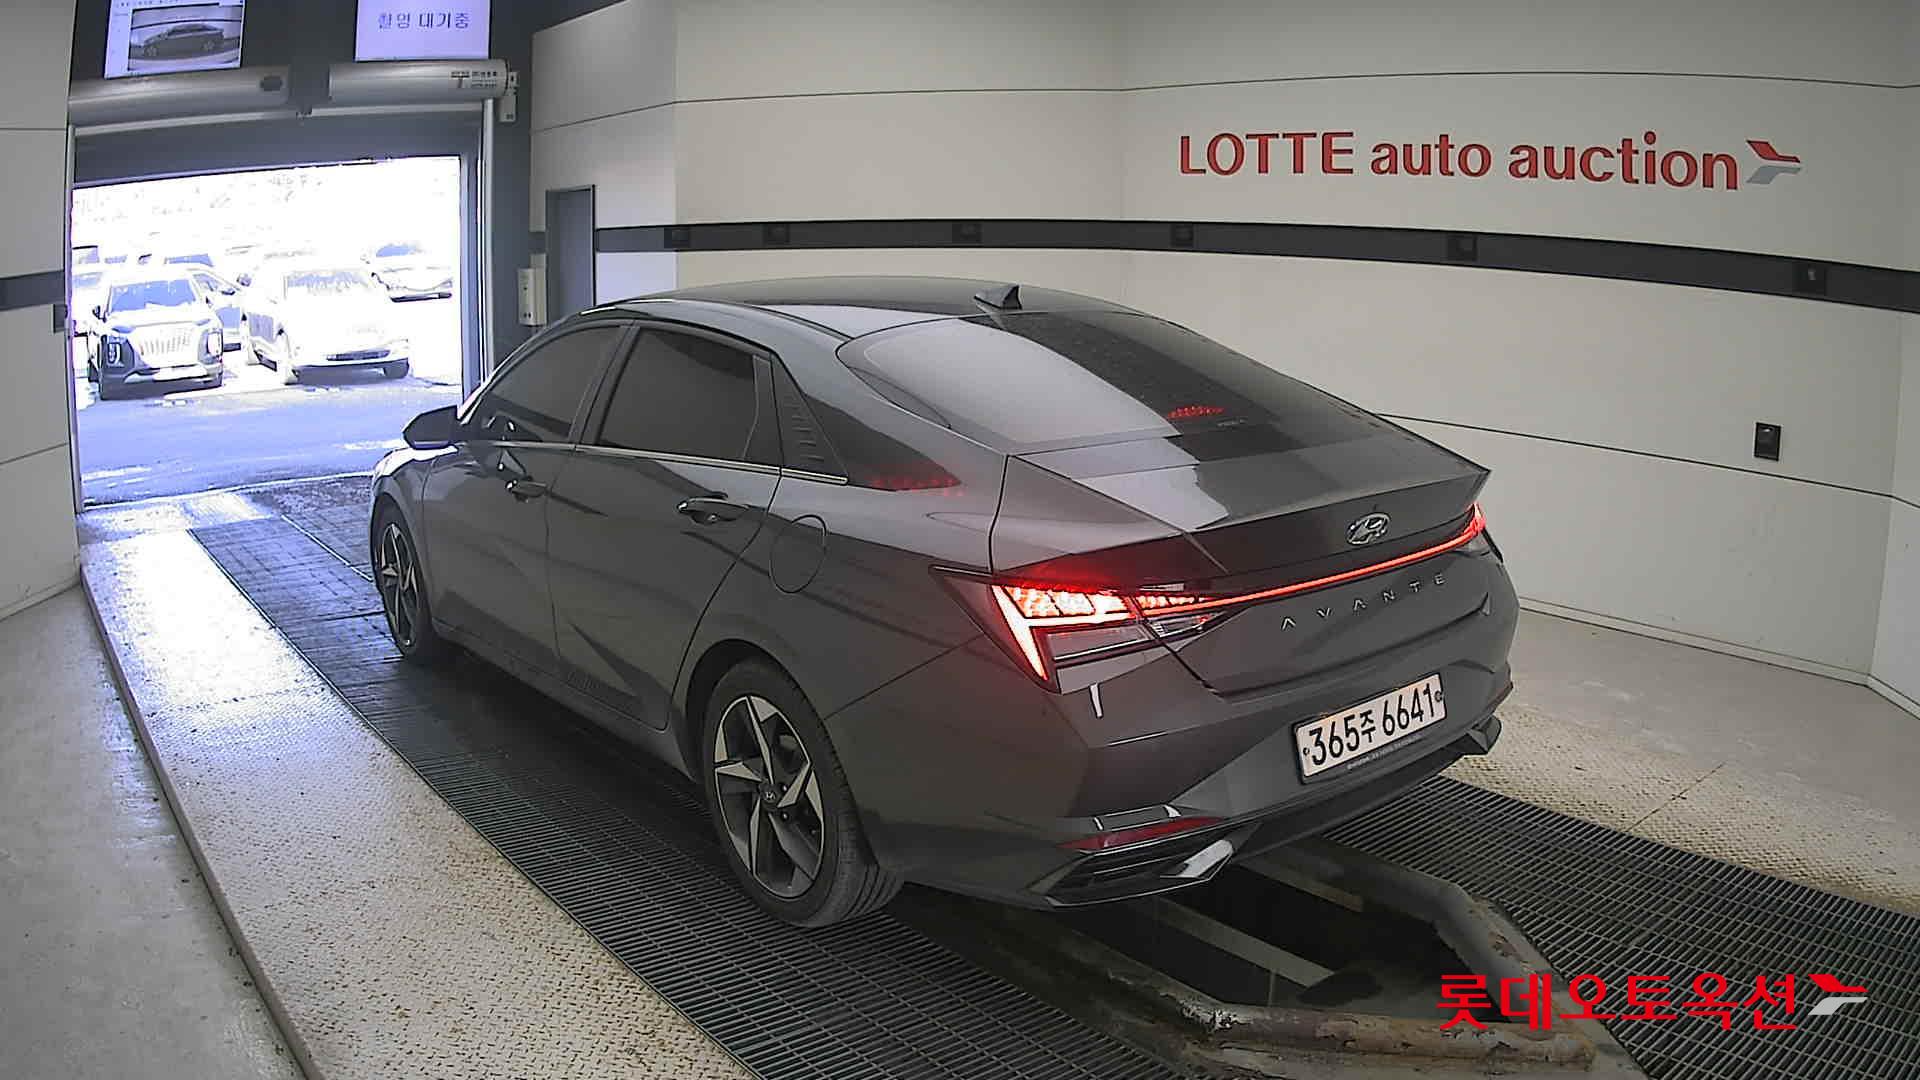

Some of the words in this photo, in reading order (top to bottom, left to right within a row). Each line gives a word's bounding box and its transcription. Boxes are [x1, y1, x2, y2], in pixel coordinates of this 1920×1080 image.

[418, 12, 470, 29] 대기중
[1180, 131, 1354, 176] LOTTE
[1370, 134, 1492, 177] auto
[1508, 131, 1738, 190] auction
[1280, 572, 1446, 631] AVANTE
[1308, 710, 1377, 766] 365주
[1382, 683, 1436, 737] 6641
